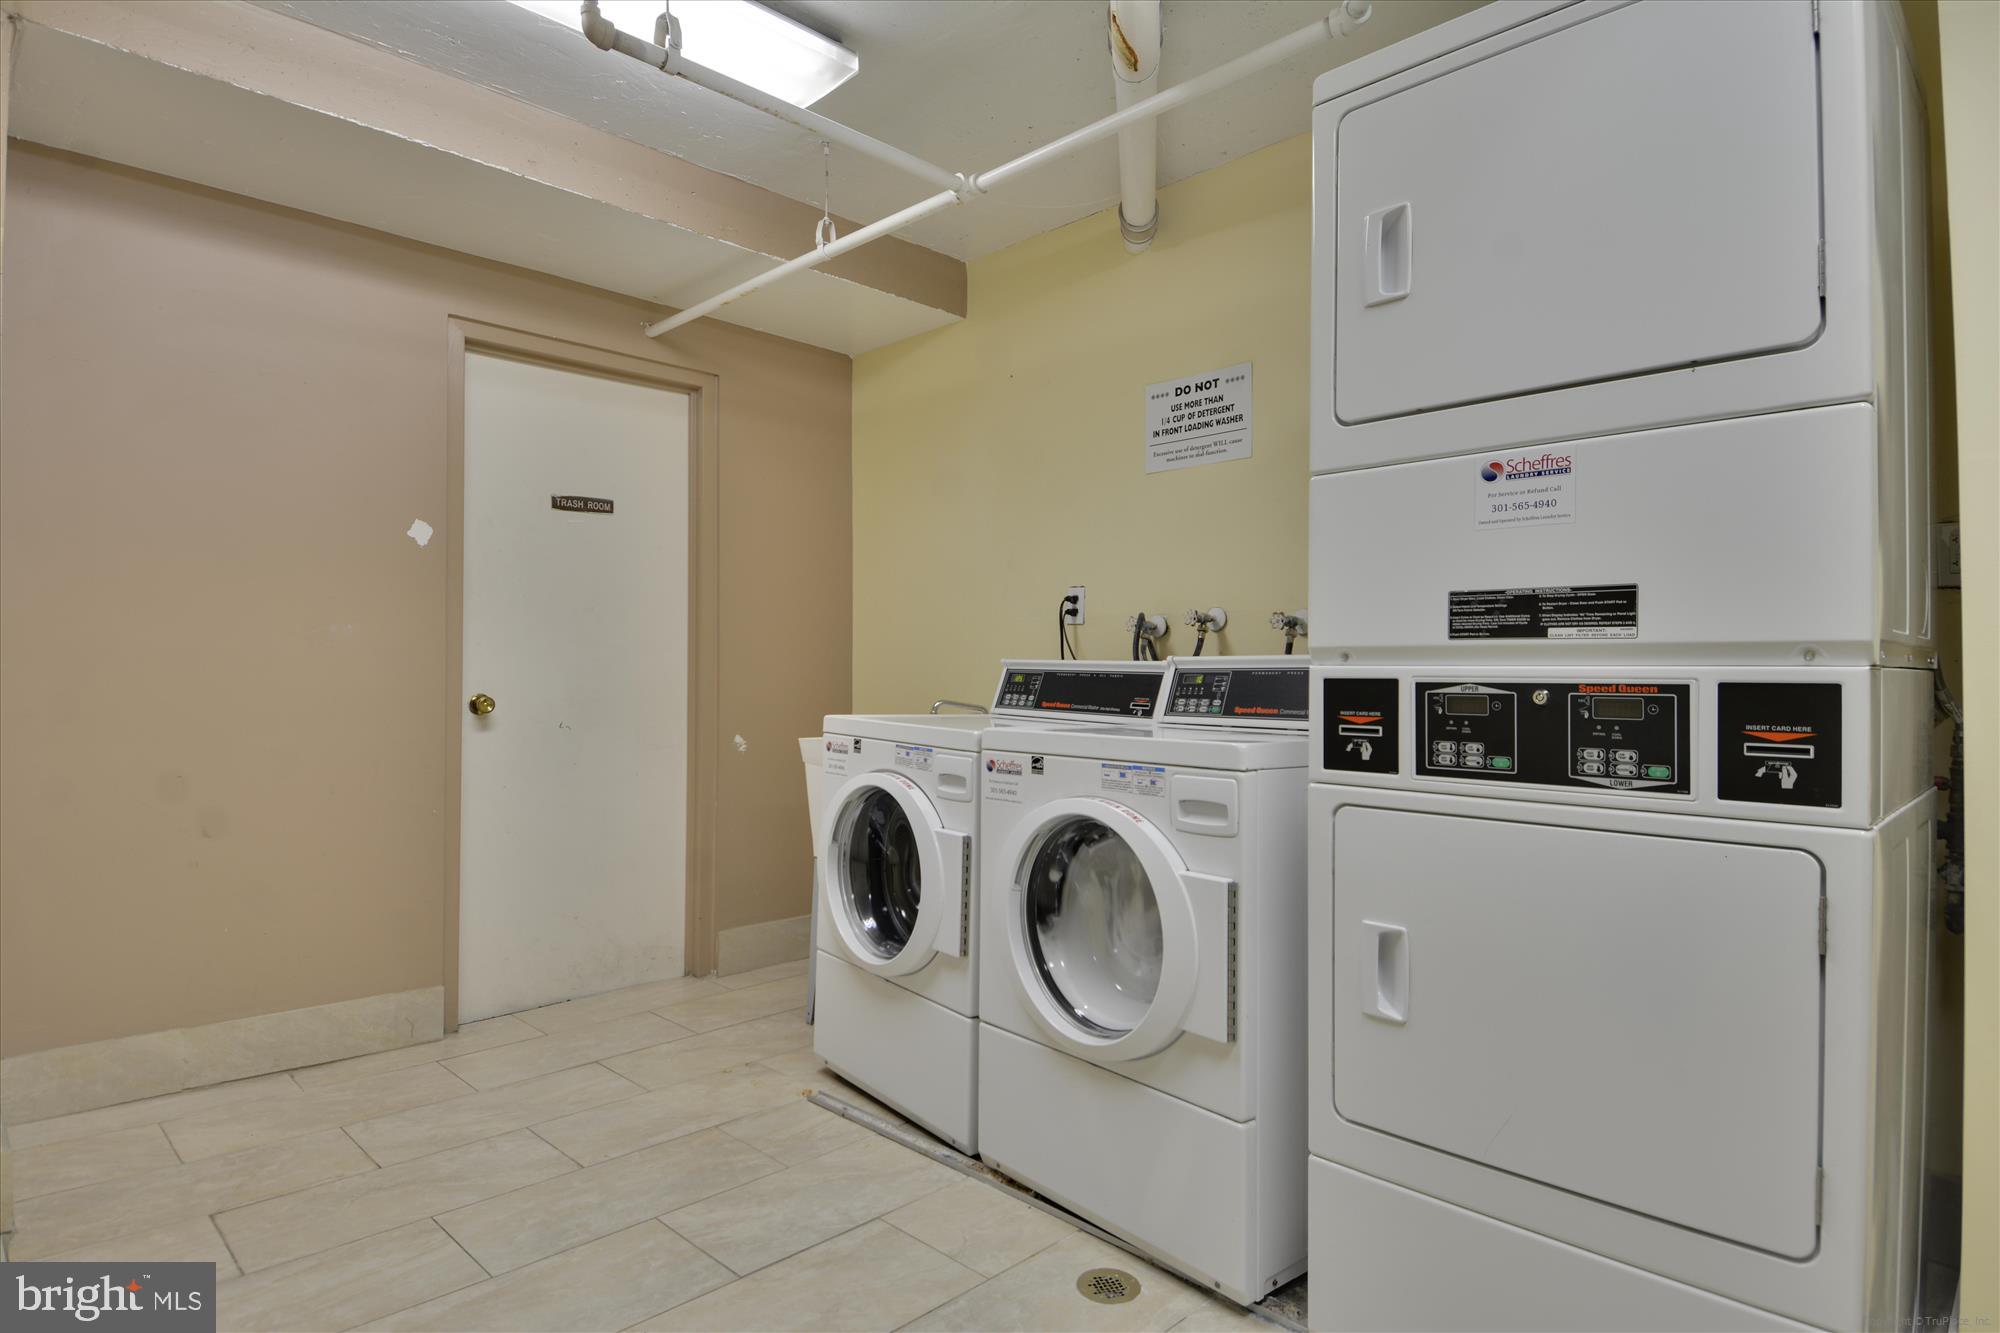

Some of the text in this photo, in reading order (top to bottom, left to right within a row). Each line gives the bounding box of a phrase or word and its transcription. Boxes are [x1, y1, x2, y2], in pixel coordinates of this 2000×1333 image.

[1174, 378, 1220, 397] DO NOT
[1170, 394, 1224, 412] USE MORE THAN
[1162, 404, 1235, 426] 1/4 CUP OF DETERGENT
[1162, 426, 1182, 437] FRONT
[1184, 420, 1214, 432] LOADING
[1215, 414, 1244, 426] WASHER
[1213, 439, 1227, 448] WILL
[1506, 454, 1572, 473] Scheffres
[1506, 467, 1571, 480] LAUNDRY SERVICE
[556, 498, 610, 511] TRASH ROOM
[1491, 498, 1557, 513] 301-565-4940
[1578, 684, 1658, 694] Speed Queen
